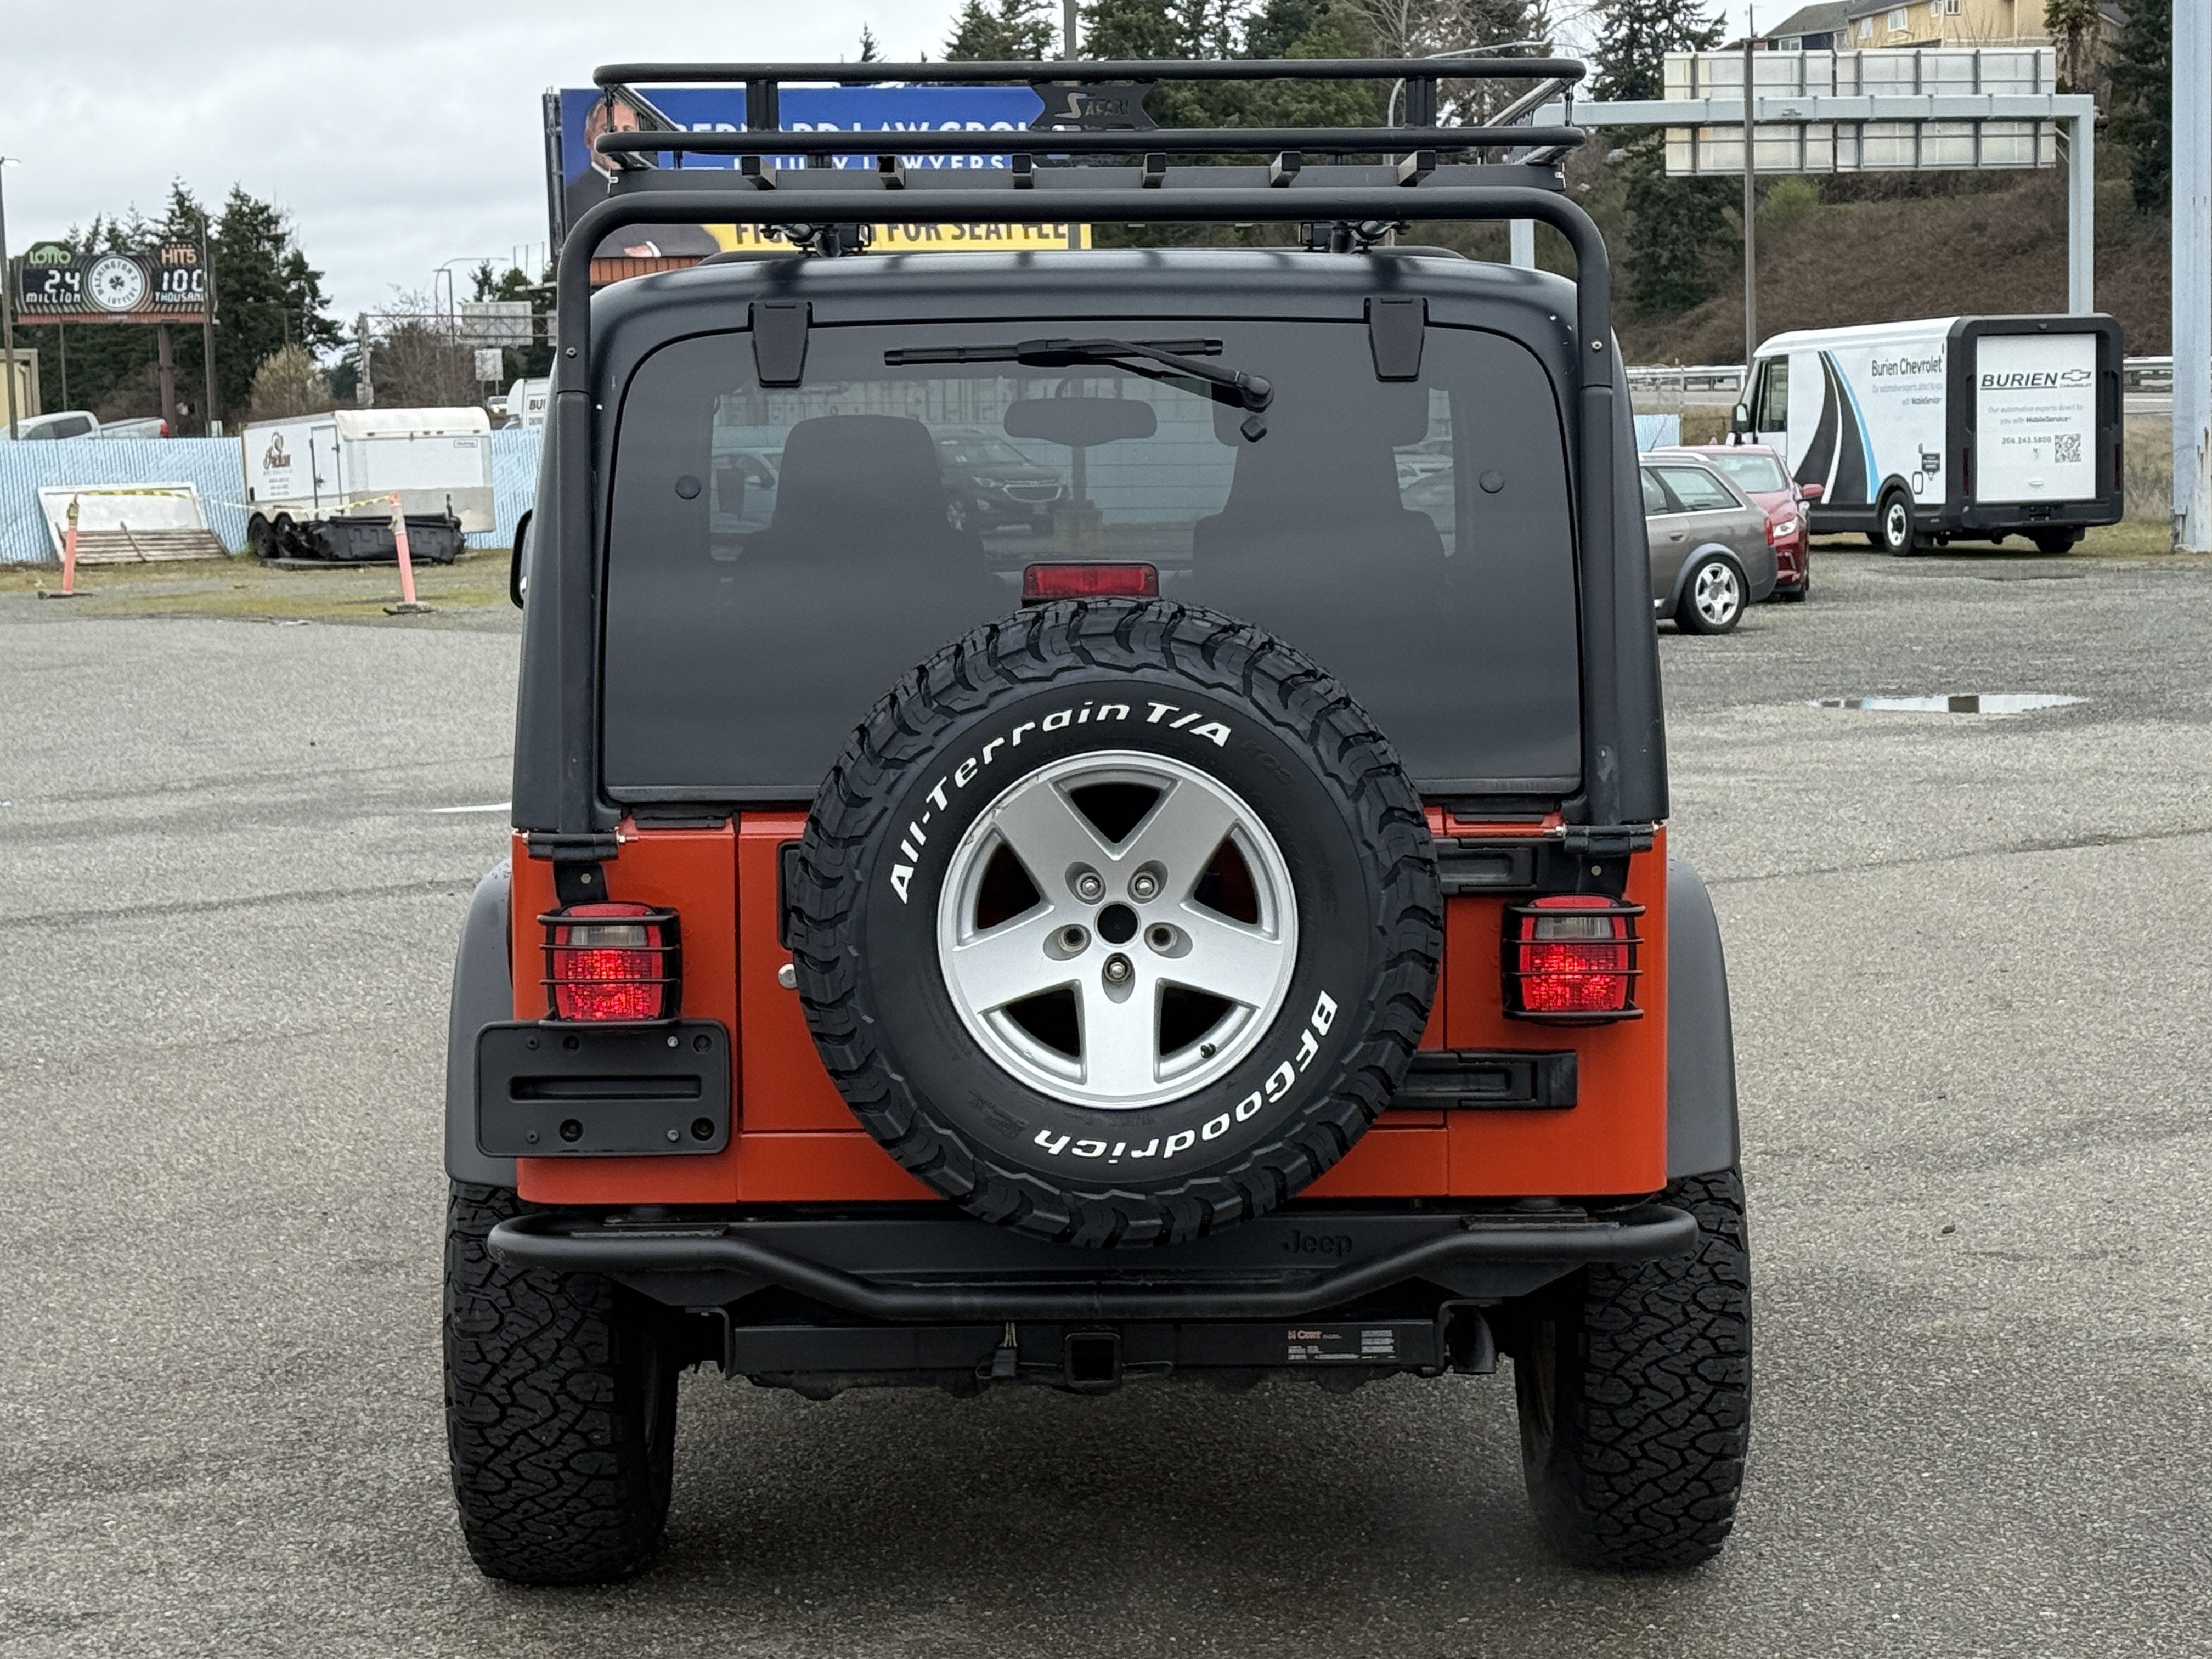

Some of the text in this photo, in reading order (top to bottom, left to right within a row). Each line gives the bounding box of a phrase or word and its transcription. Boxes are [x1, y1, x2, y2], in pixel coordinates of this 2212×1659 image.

[30, 245, 71, 264] LOTTO
[44, 269, 81, 293] 24
[1871, 354, 1942, 377] Burien Chevrolet
[1981, 372, 2058, 387] BURIEN
[890, 701, 1232, 904] All-Terrain T/A
[1034, 990, 1338, 1164] BFGoodrich
[1282, 1231, 1353, 1258] Jeep
